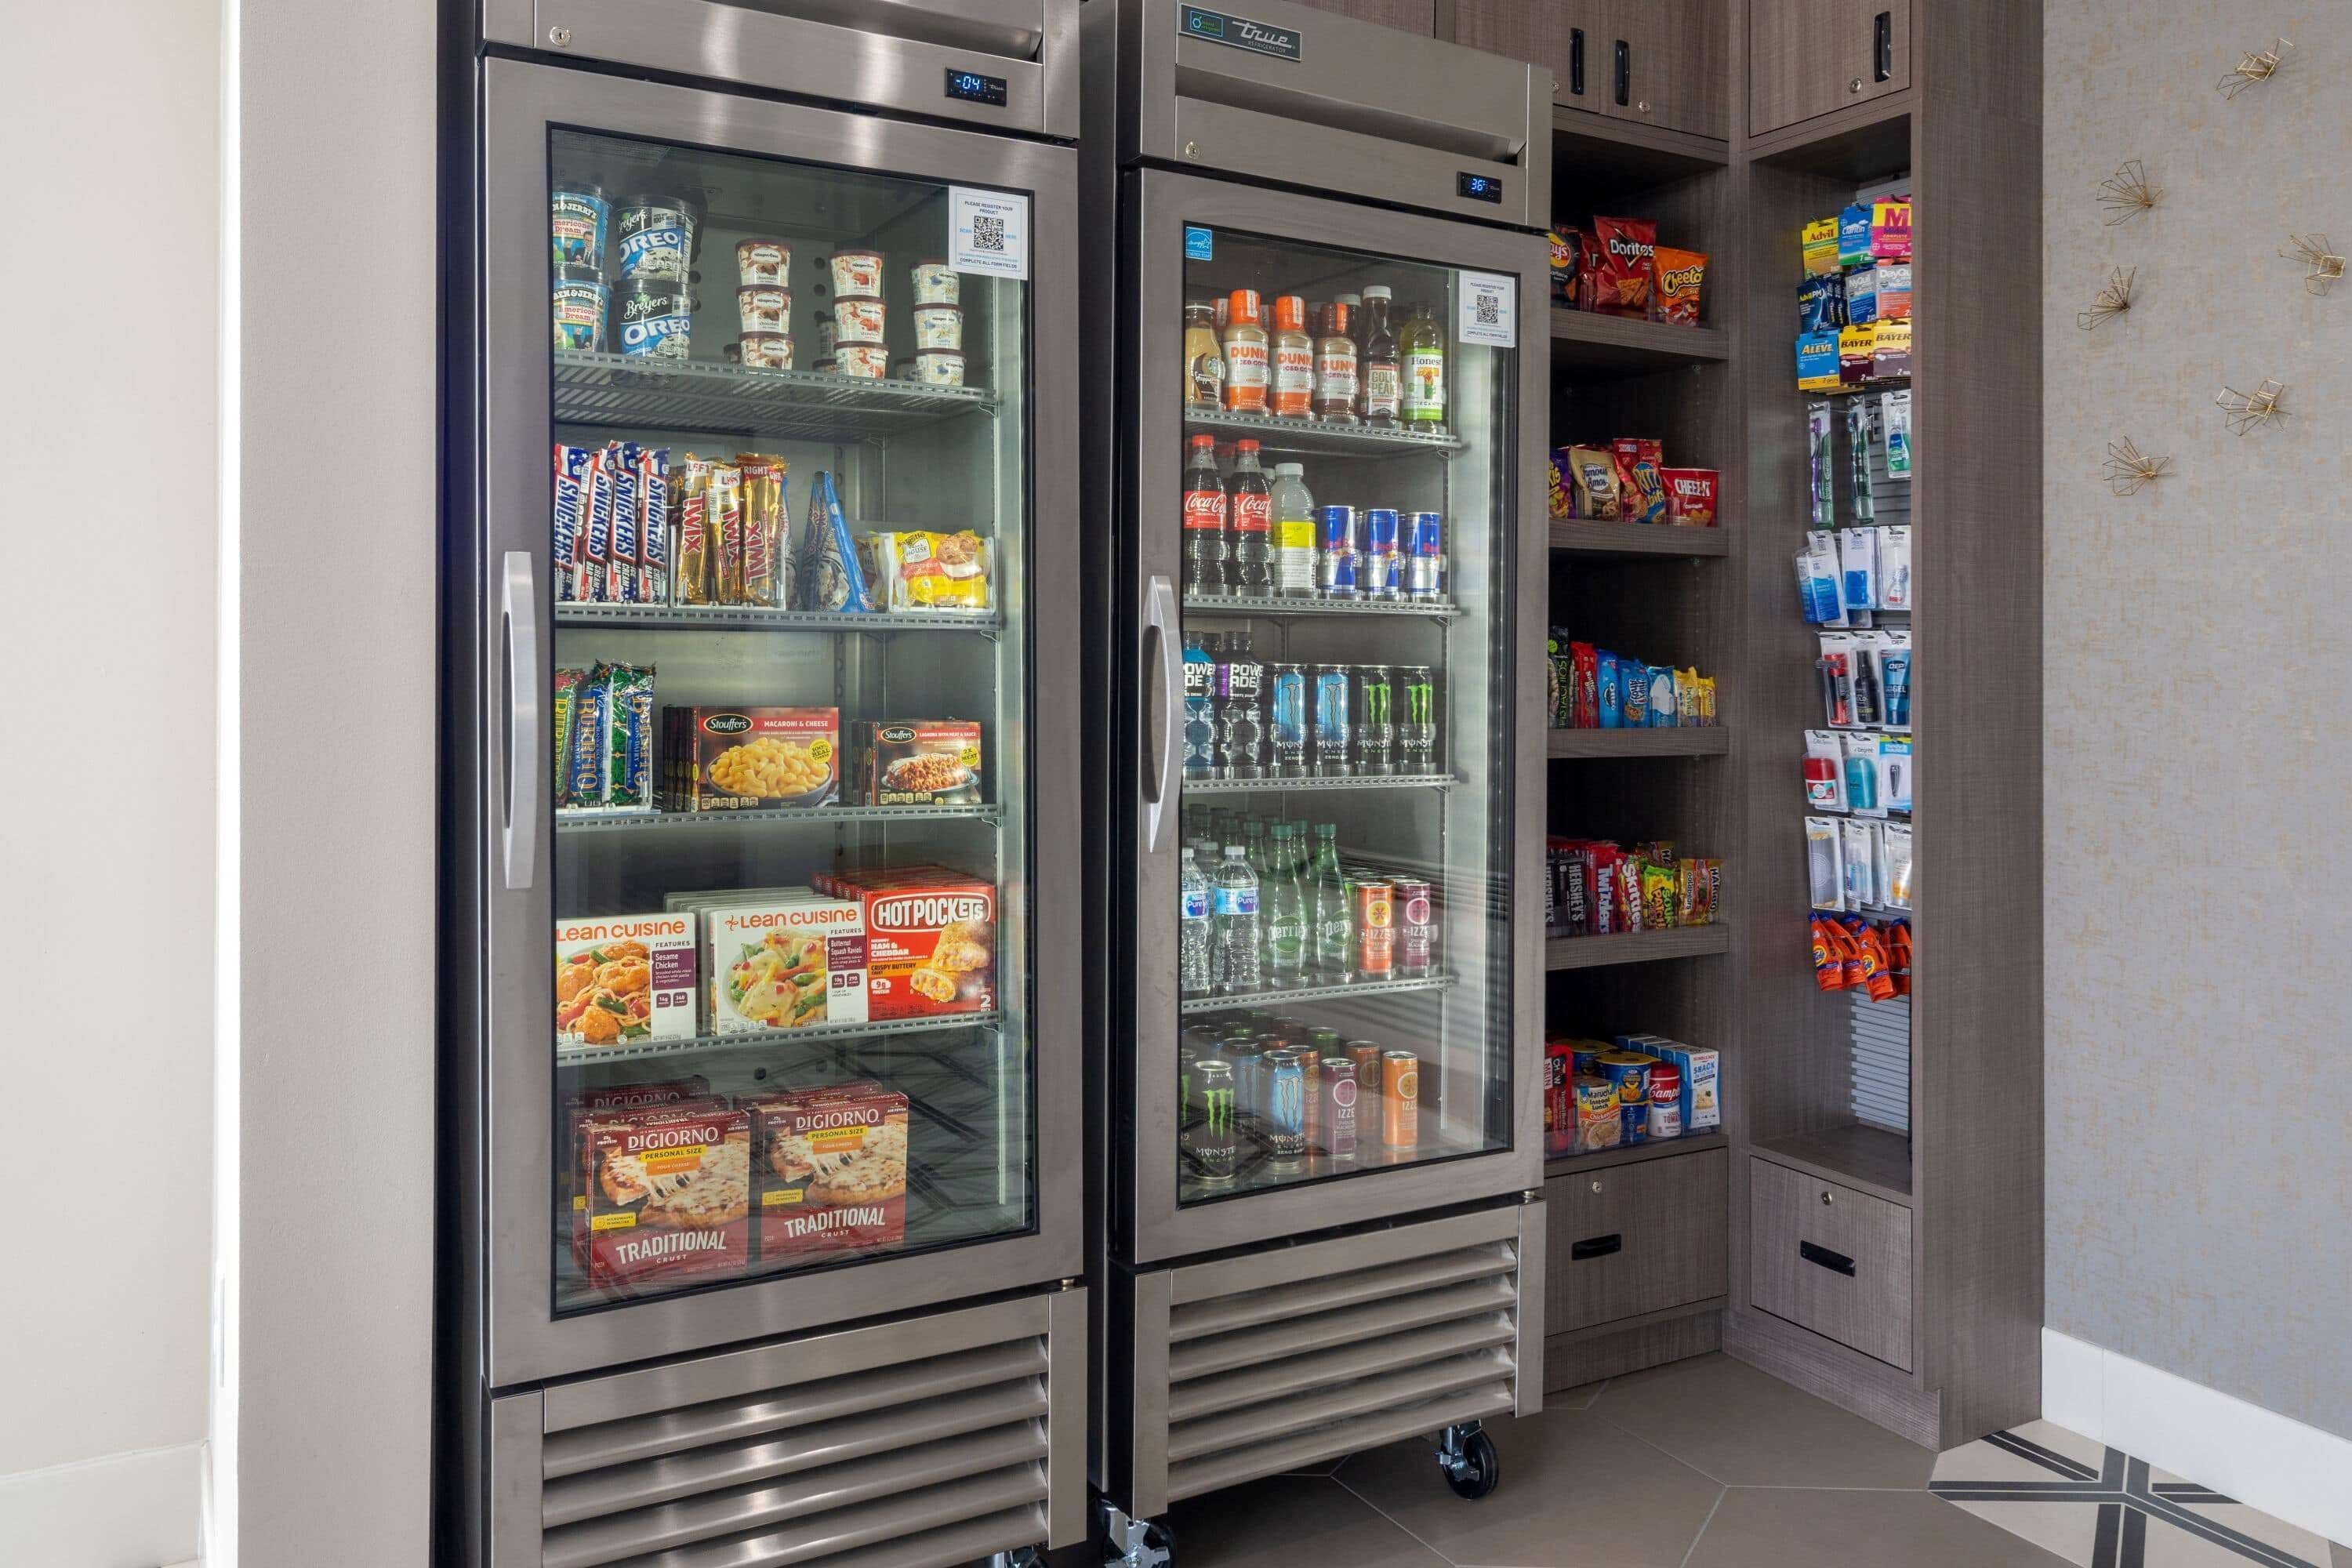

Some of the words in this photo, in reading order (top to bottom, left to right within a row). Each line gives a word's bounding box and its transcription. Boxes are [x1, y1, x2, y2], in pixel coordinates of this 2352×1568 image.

[1247, 40, 1287, 54] REFRIGERATOR
[955, 76, 979, 90] -04
[1809, 229, 1834, 241] Advil
[1842, 226, 1865, 235] Claritin
[1610, 239, 1654, 257] Doritos
[1663, 269, 1703, 295] Cheeto
[624, 296, 668, 320] Breyers
[624, 319, 690, 346] OREO
[1876, 333, 1911, 342] BAYER
[1802, 343, 1833, 355] ALEVE
[1841, 339, 1872, 348] BAYER
[743, 466, 769, 476] RIGHT
[555, 479, 579, 566] SNICKERS
[590, 475, 613, 560] SNICKERS
[615, 471, 637, 559] SNICKERS
[645, 476, 666, 564] SNICKERS
[682, 490, 707, 555] TWIX
[745, 521, 769, 587] TWIX
[709, 718, 747, 731] Stouffer's
[576, 696, 597, 789] BURRITO
[884, 730, 913, 740] Stouffer's
[1569, 864, 1584, 922] HERSHEY'S
[1709, 866, 1720, 912] HARIBO
[878, 901, 913, 927] HOT
[913, 898, 985, 927] POCKETS
[740, 913, 786, 929] Lean
[871, 949, 909, 957] CHEDDAR
[655, 961, 679, 970] Chicken
[980, 994, 992, 1008] 2
[1544, 1063, 1553, 1087] MEIN
[1693, 1063, 1715, 1074] SNACK
[796, 1109, 880, 1131] DIGIORNO
[1338, 1108, 1356, 1119] IZZE
[628, 1127, 720, 1151] DIGIORNO
[811, 1130, 848, 1139] PERSONAL
[645, 1150, 684, 1160] PERSONAL
[686, 1147, 702, 1156] SIZE
[784, 1208, 886, 1239] TRADITIONAL
[821, 1229, 850, 1239] CRUST
[615, 1231, 728, 1265] TRADITIONAL
[656, 1254, 688, 1264] CRUST
